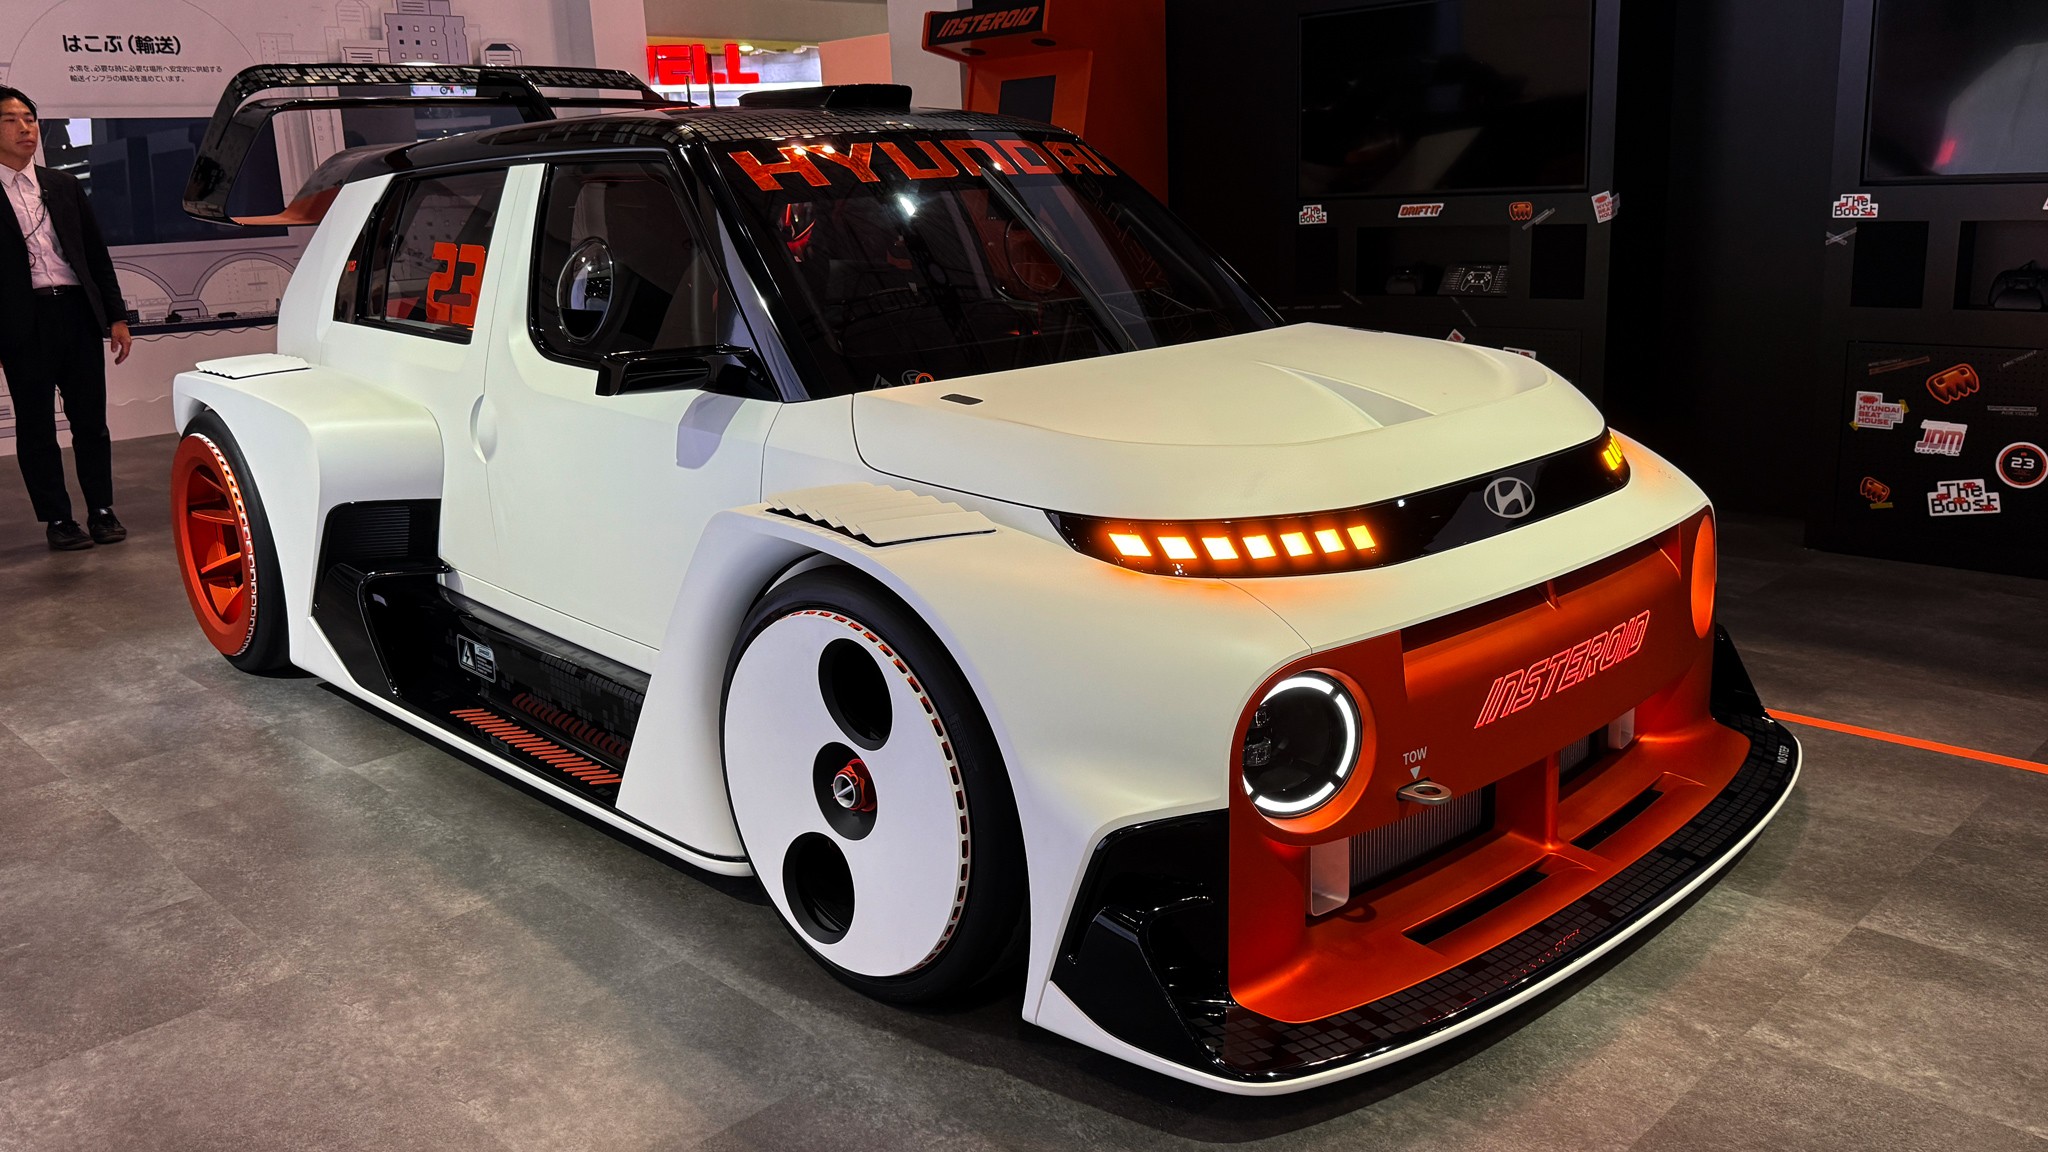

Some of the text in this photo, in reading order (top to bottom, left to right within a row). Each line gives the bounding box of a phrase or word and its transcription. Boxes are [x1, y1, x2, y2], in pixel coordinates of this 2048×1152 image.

[937, 6, 1040, 38] INSTEROID
[62, 34, 181, 55] はこぶ（輸送）
[728, 138, 1117, 192] HYUNDAI
[426, 241, 486, 326] 23
[1859, 404, 1900, 413] HYUNDAI
[1858, 417, 1889, 425] HOUSE
[1917, 429, 1964, 451] JDM
[2011, 457, 2035, 469] 23
[1940, 482, 1983, 498] The
[1931, 495, 1998, 514] Boost
[1474, 609, 1650, 729] INSTEROID
[1402, 746, 1427, 765] TOW
